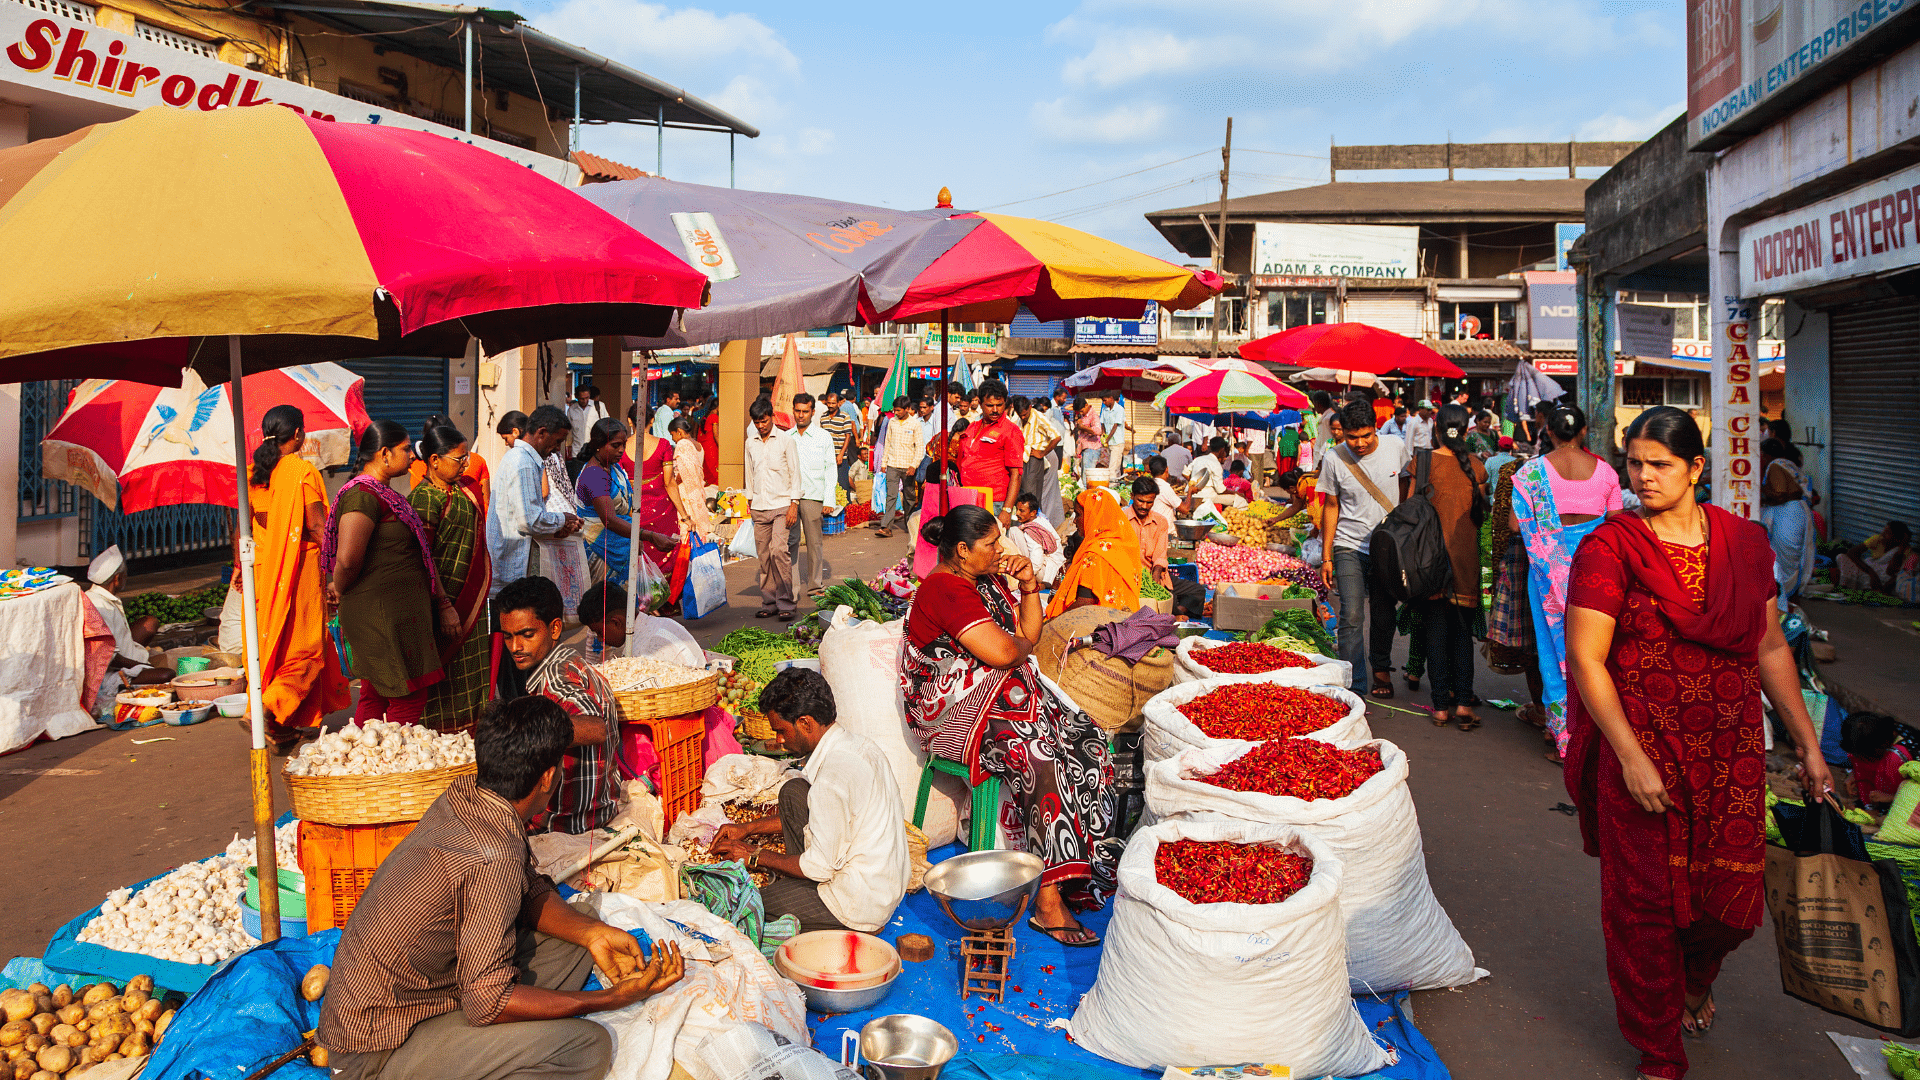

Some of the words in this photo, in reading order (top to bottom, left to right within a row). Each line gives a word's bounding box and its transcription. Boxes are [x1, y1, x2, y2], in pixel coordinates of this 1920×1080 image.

[6, 18, 336, 123] Shirodk
[1702, 83, 1763, 135] NOORANI
[700, 228, 724, 268] Coke
[806, 220, 893, 254] Coke
[1753, 219, 1822, 282] NOORANI
[1263, 263, 1307, 275] ADAM
[1313, 264, 1323, 275] &
[1330, 265, 1408, 279] COMPANY
[966, 335, 990, 345] CENTRE
[1726, 321, 1752, 405] CASA
